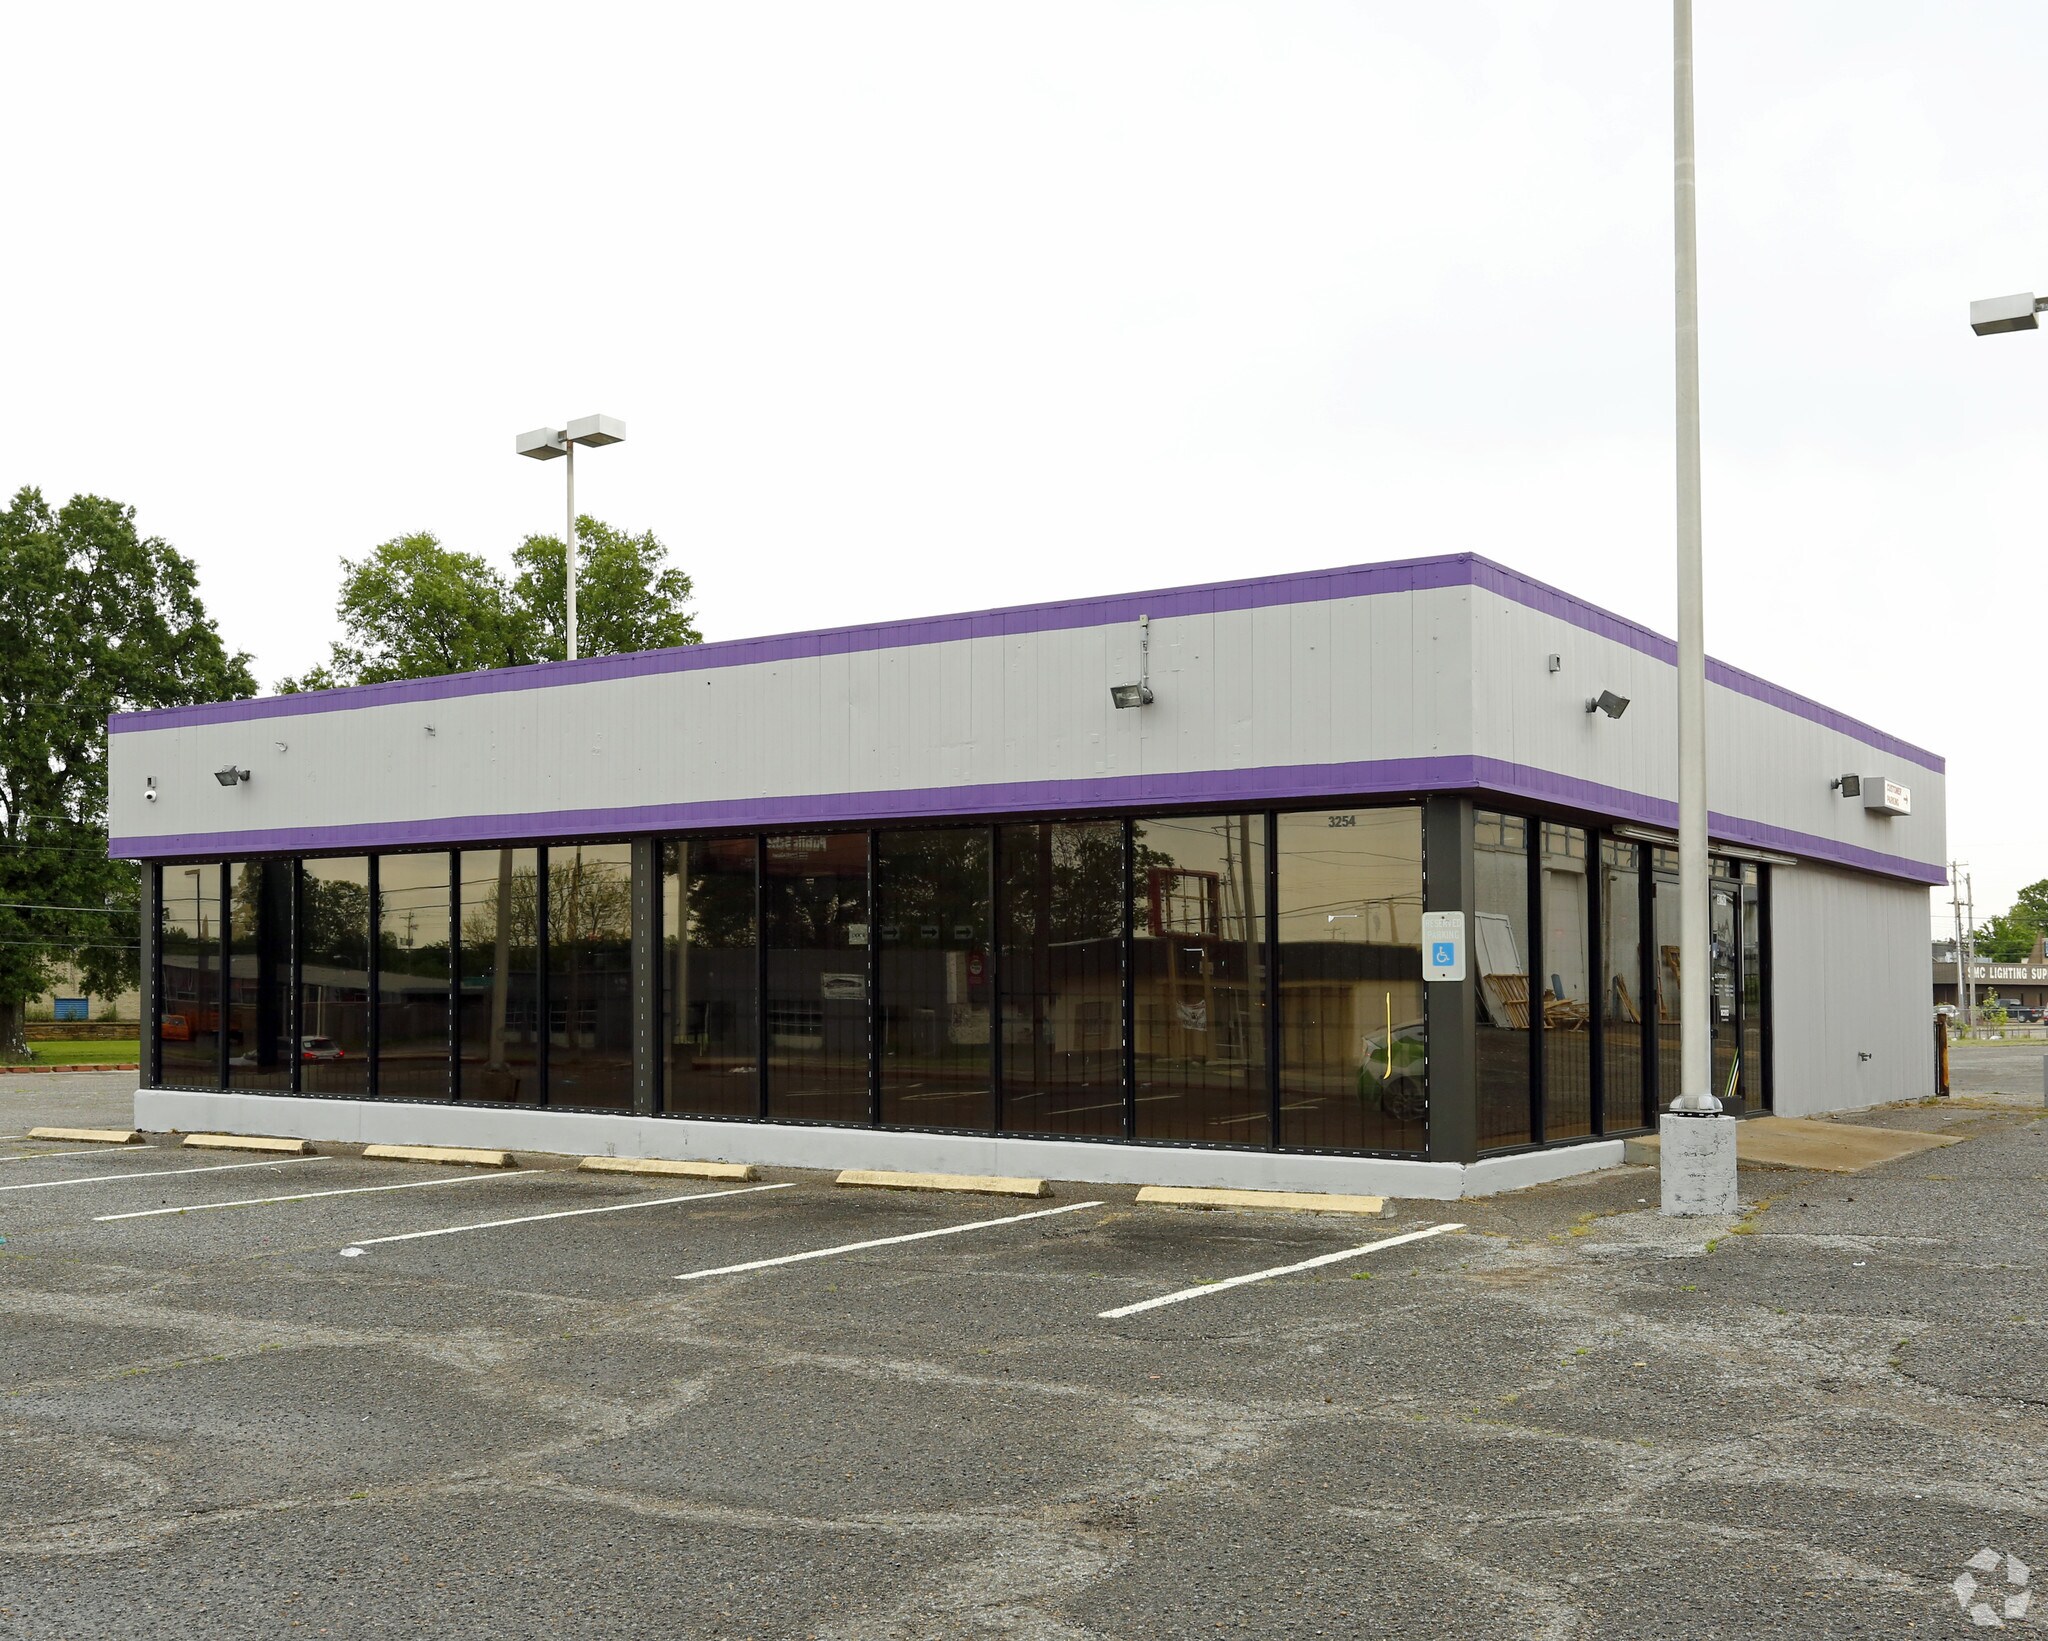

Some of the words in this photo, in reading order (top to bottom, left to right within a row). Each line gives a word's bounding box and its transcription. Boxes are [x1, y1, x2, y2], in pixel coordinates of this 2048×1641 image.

[1328, 815, 1356, 828] 3254
[1426, 918, 1461, 928] RESERVED
[1427, 930, 1459, 940] PARKING
[1989, 966, 2028, 980] LIGHTING
[2031, 967, 2048, 980] SUP
